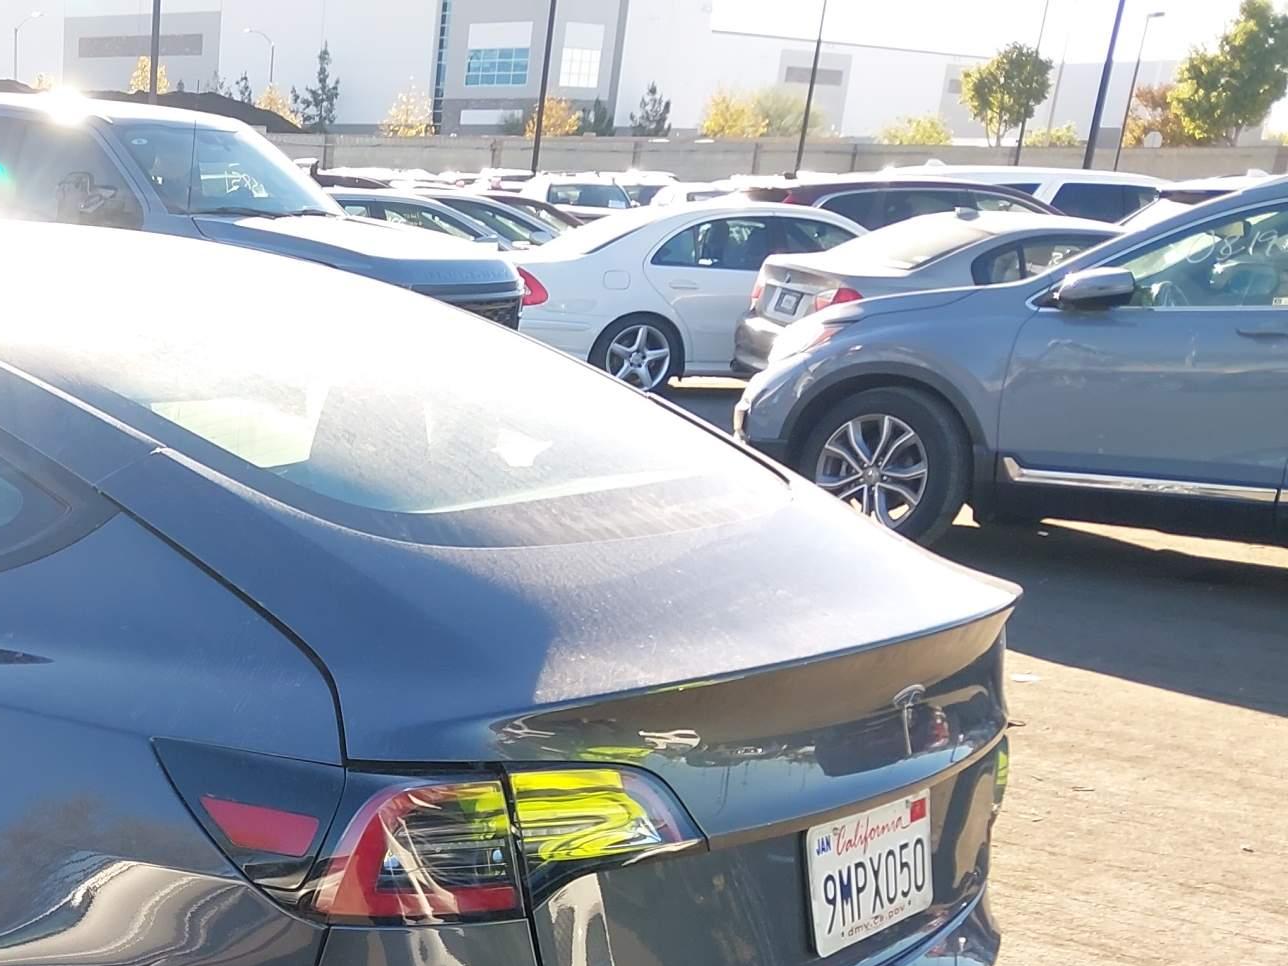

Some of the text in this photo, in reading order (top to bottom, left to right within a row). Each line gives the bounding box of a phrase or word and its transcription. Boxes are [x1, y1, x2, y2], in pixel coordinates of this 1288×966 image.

[815, 836, 832, 857] JAN
[835, 816, 911, 855] California
[823, 838, 926, 935] 9MPX050
